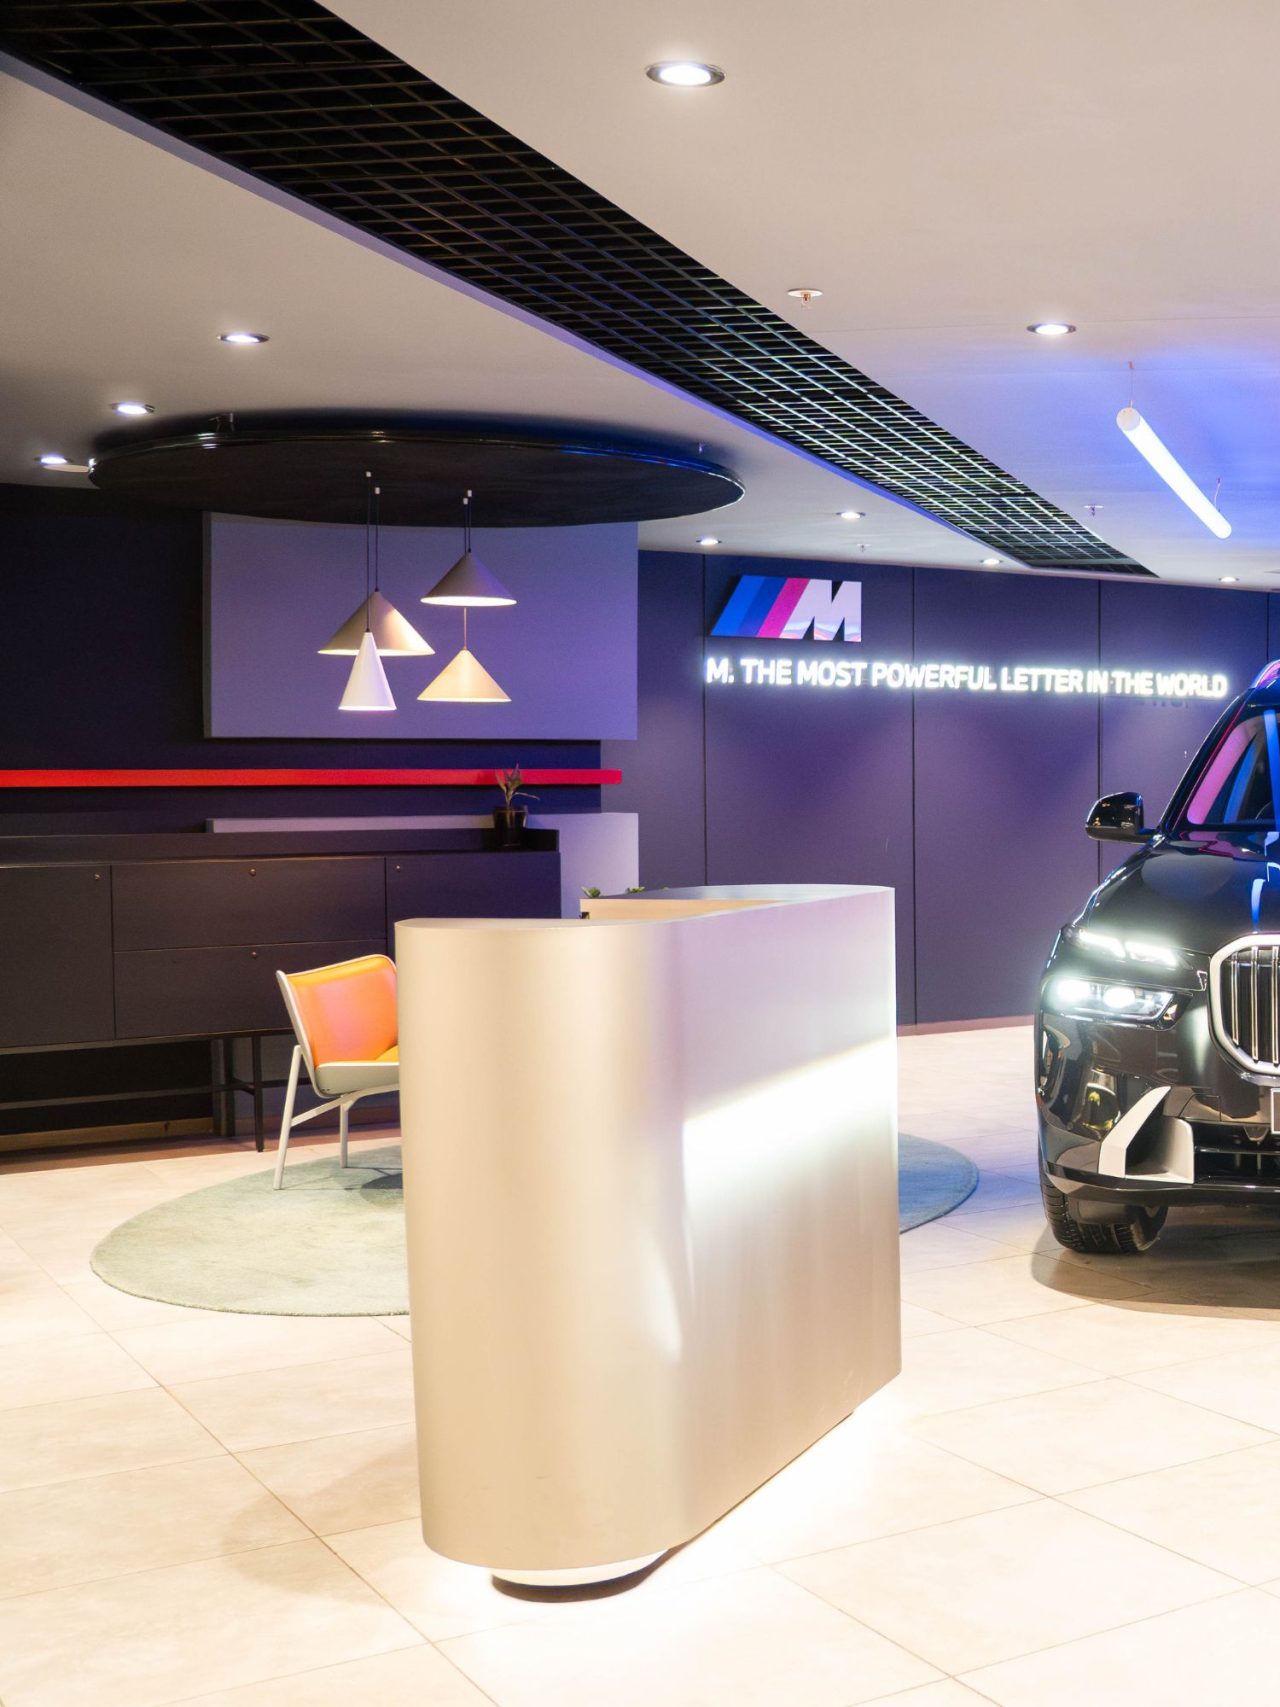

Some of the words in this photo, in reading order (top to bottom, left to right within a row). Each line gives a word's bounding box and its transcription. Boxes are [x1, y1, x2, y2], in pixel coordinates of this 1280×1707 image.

[778, 578, 863, 642] M
[706, 657, 735, 684] M.
[740, 658, 793, 686] THE
[797, 660, 868, 687] MOST
[872, 663, 997, 690] POWERFUL
[1001, 667, 1084, 693] LETTER
[1087, 670, 1109, 693] IN
[1111, 670, 1154, 696] THE
[1156, 672, 1228, 698] WORLD
